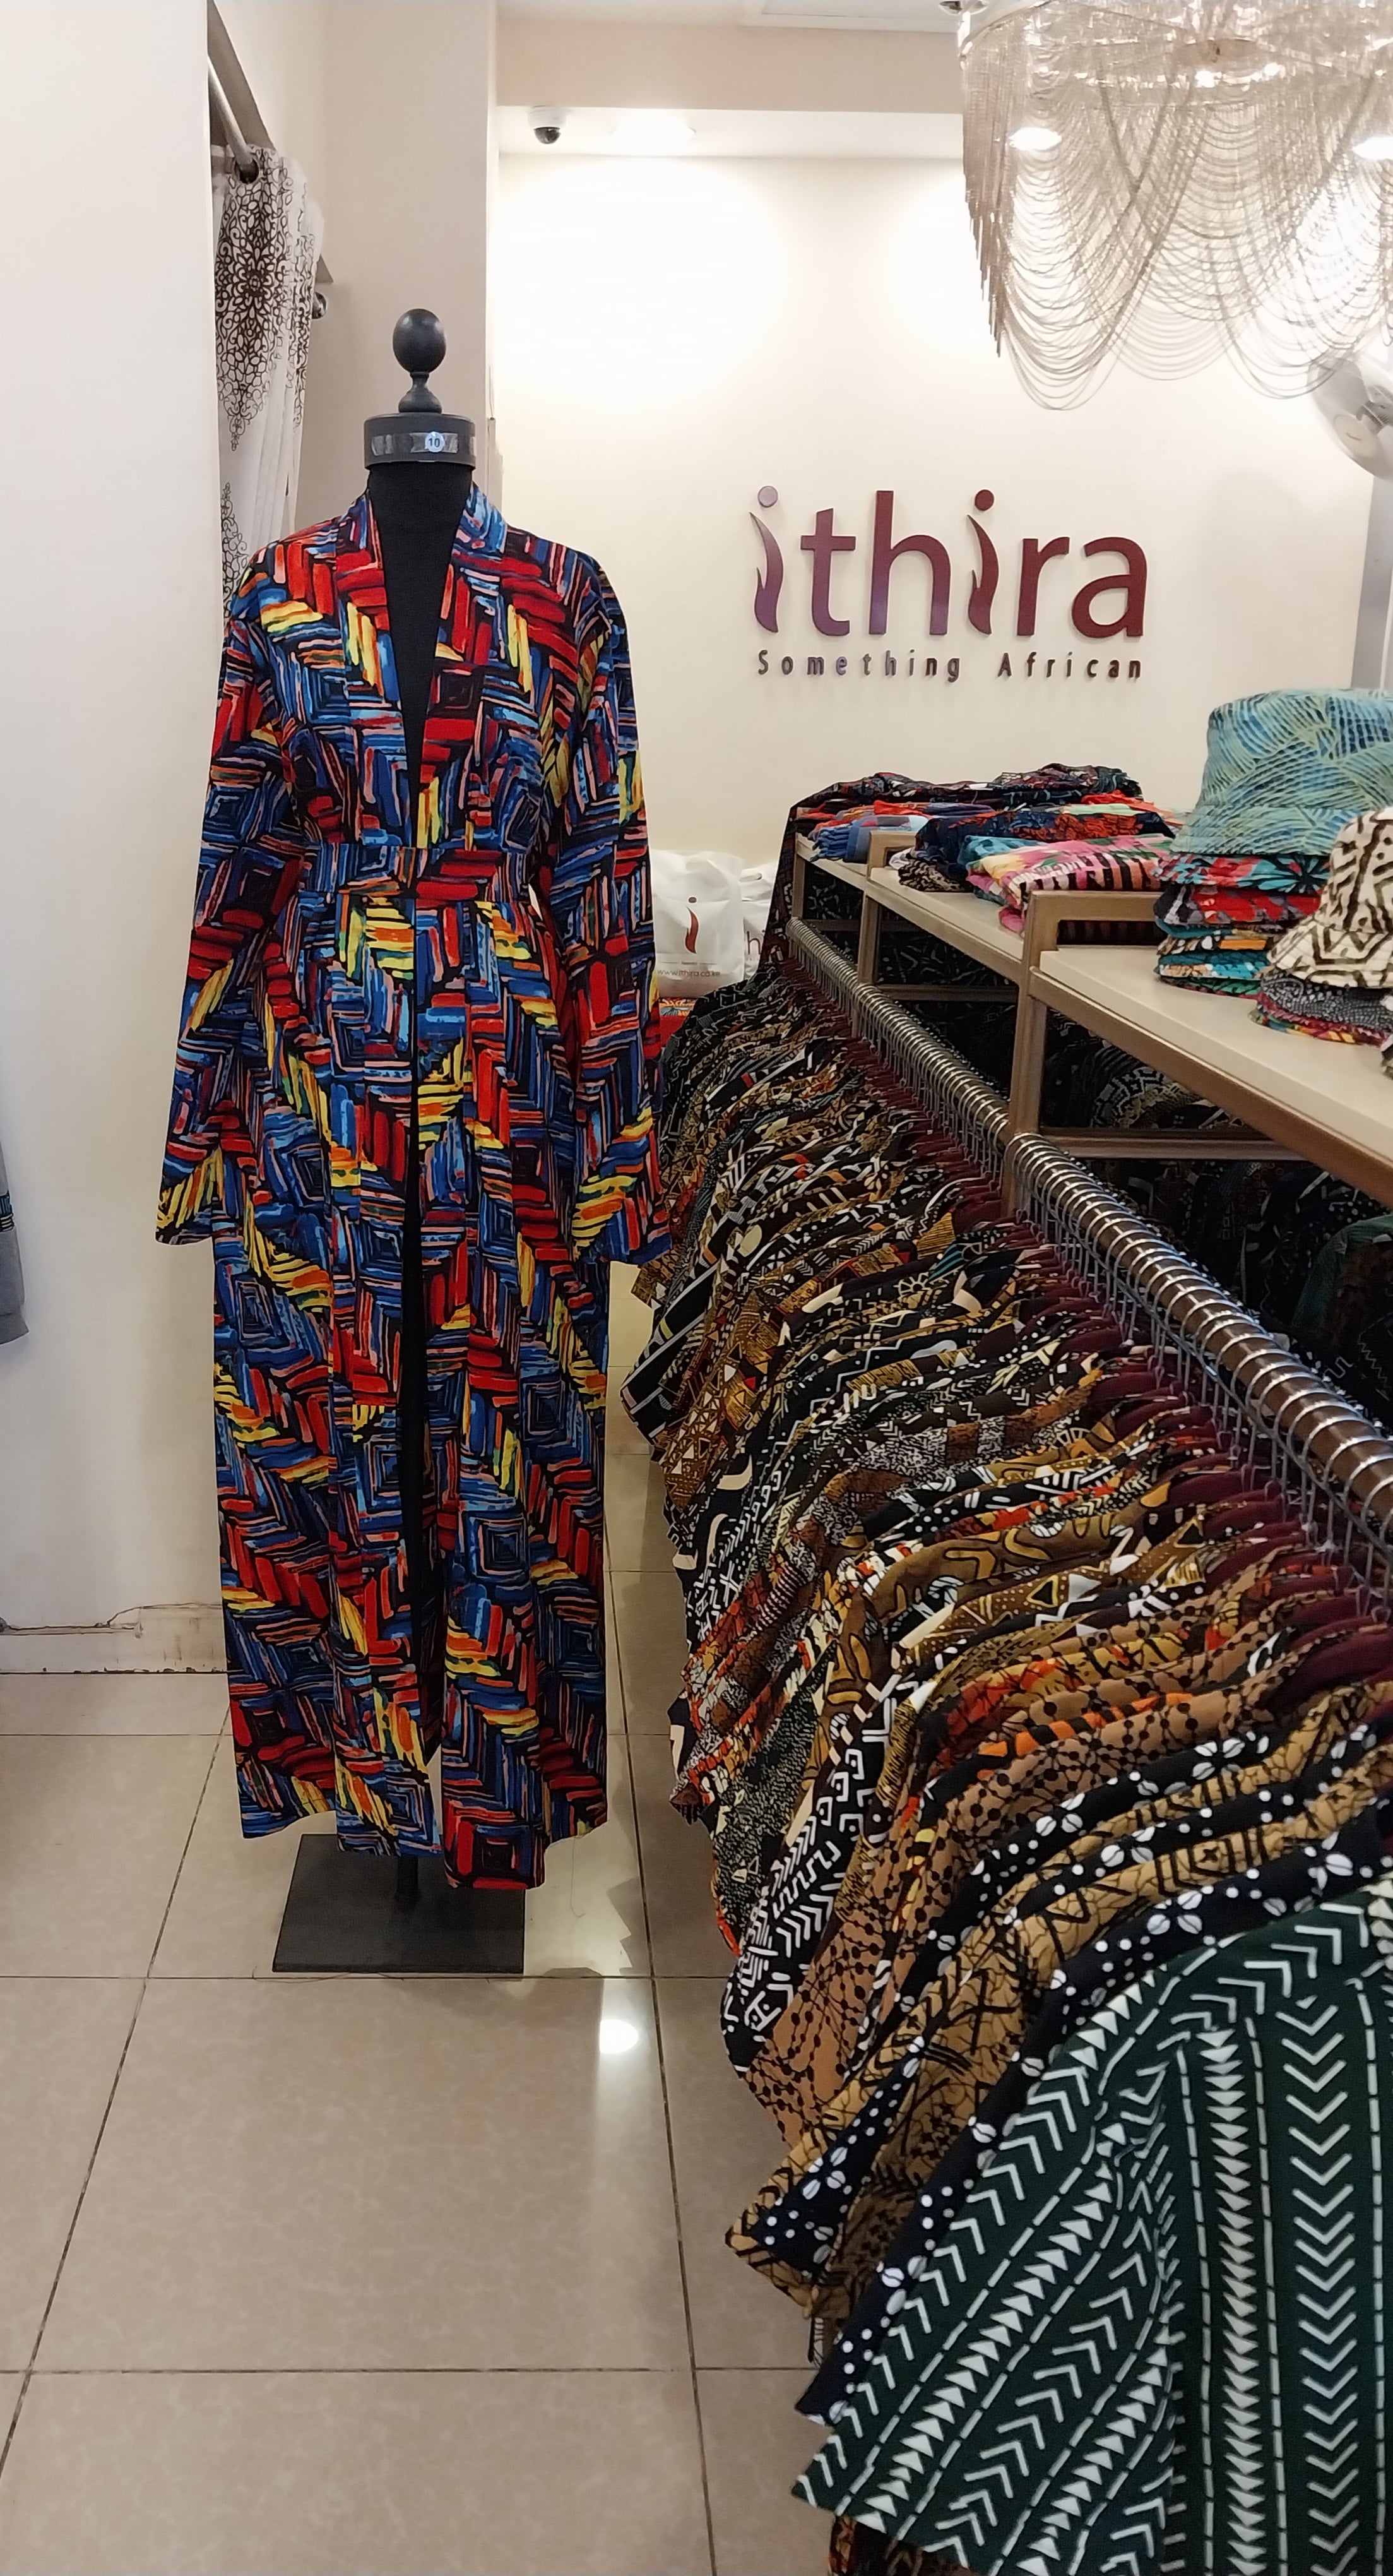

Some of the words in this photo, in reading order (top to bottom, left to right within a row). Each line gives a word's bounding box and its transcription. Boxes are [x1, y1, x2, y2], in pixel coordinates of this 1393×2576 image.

[428, 438, 441, 448] 10
[749, 485, 1147, 639] ithira
[757, 649, 960, 683] Something
[997, 651, 1141, 679] African
